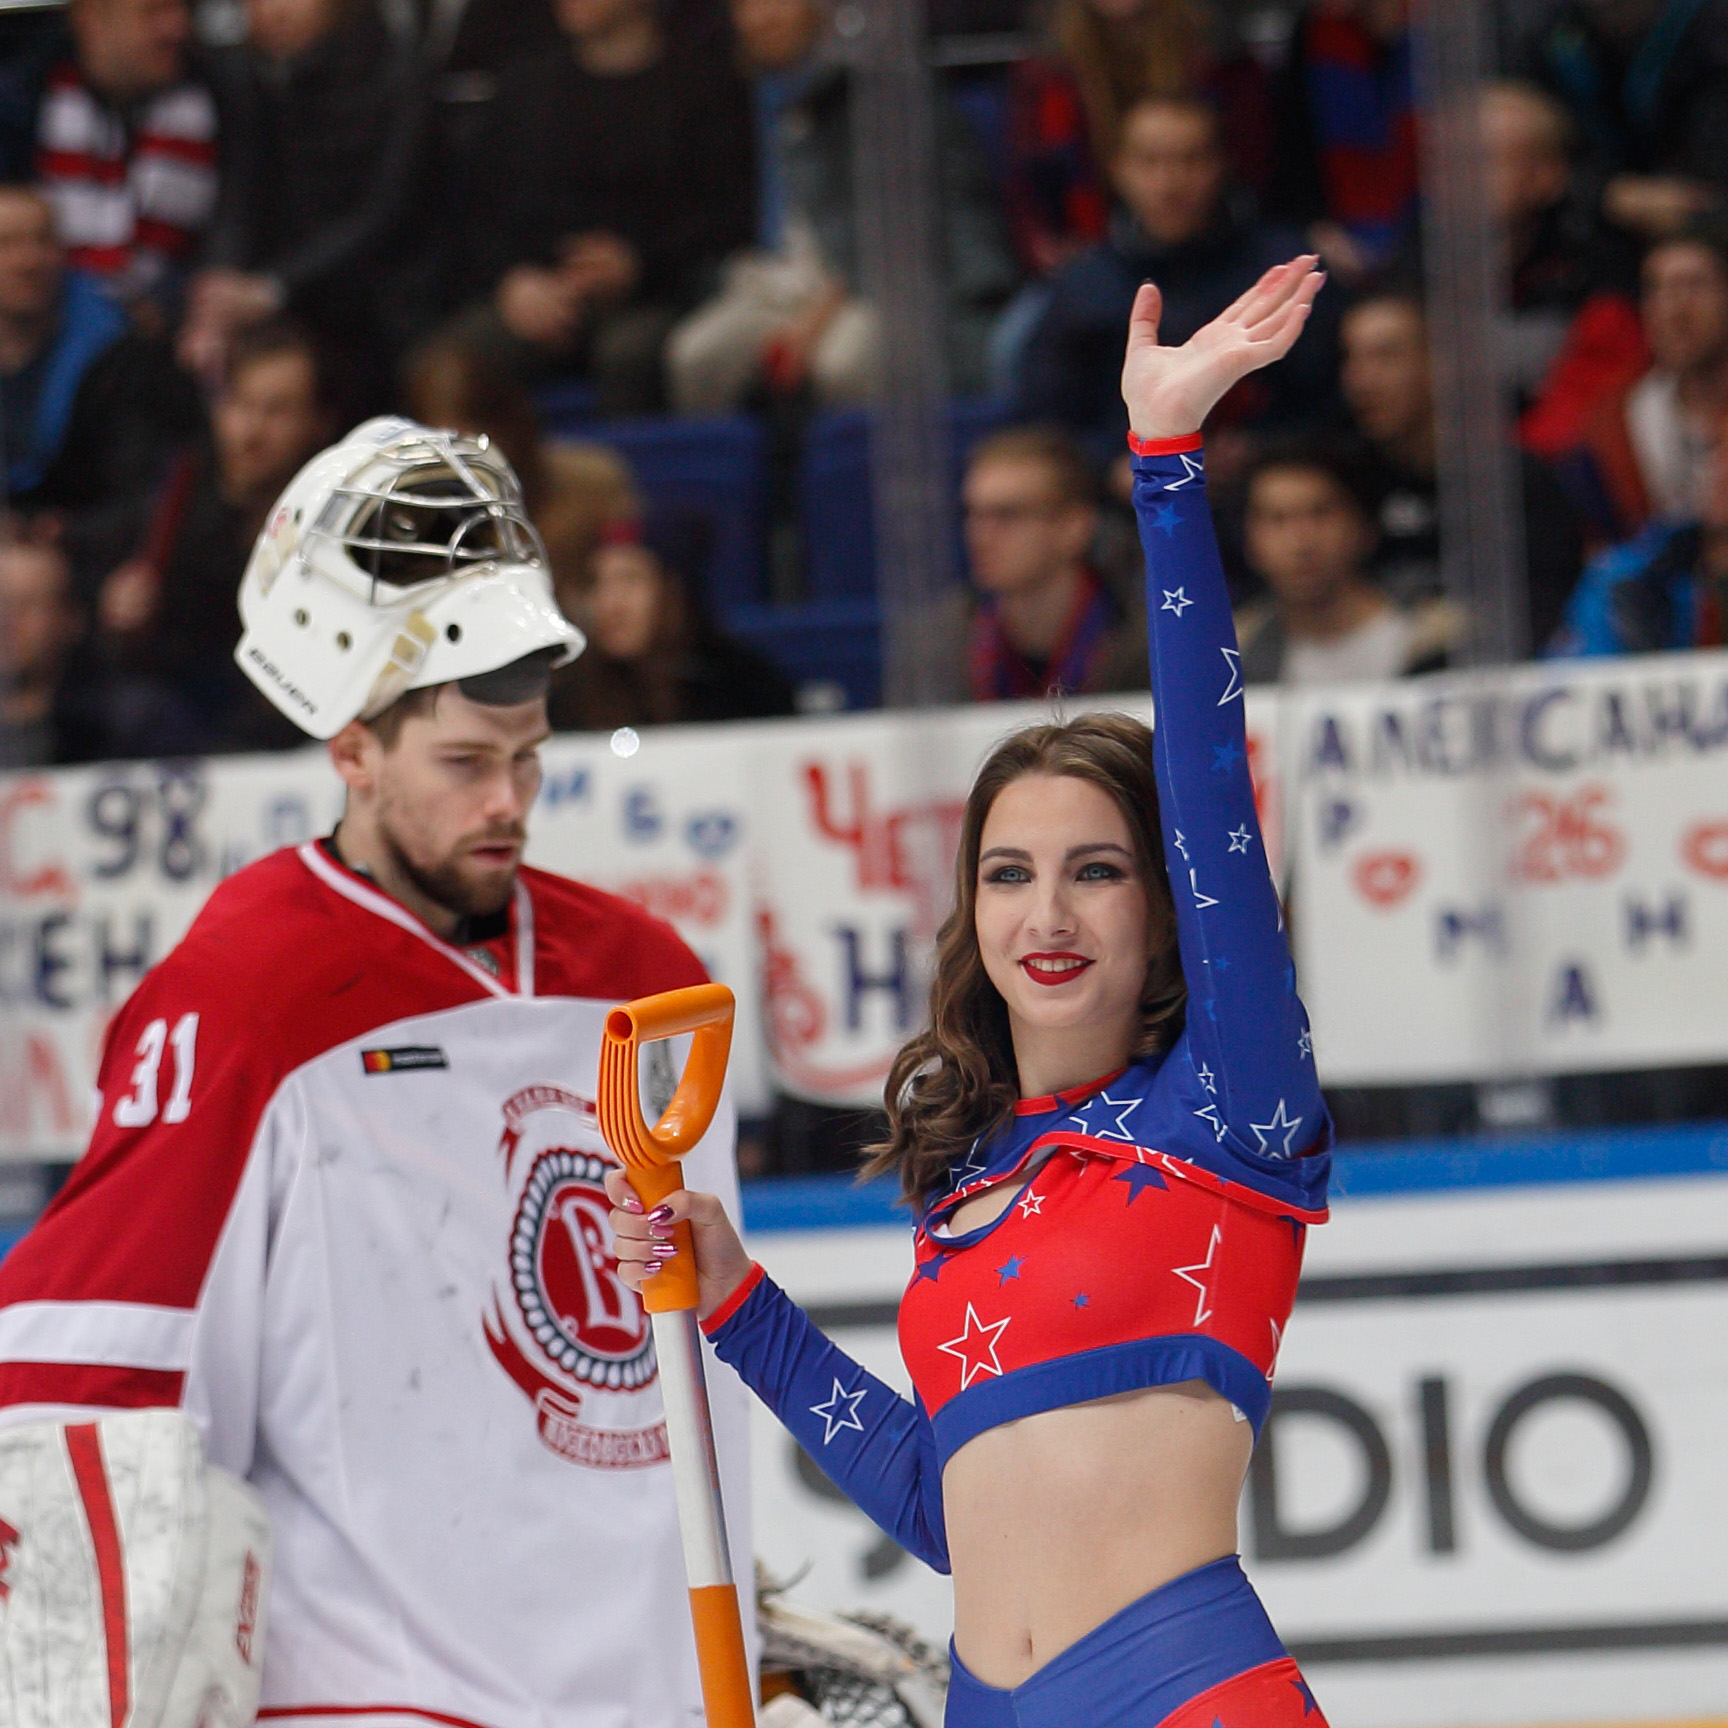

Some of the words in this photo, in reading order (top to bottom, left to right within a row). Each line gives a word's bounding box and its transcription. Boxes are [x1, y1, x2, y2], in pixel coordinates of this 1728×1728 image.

[248, 646, 319, 717] BAUER
[85, 760, 212, 888] 98
[1503, 780, 1628, 884] 26
[113, 1011, 201, 1129] 31
